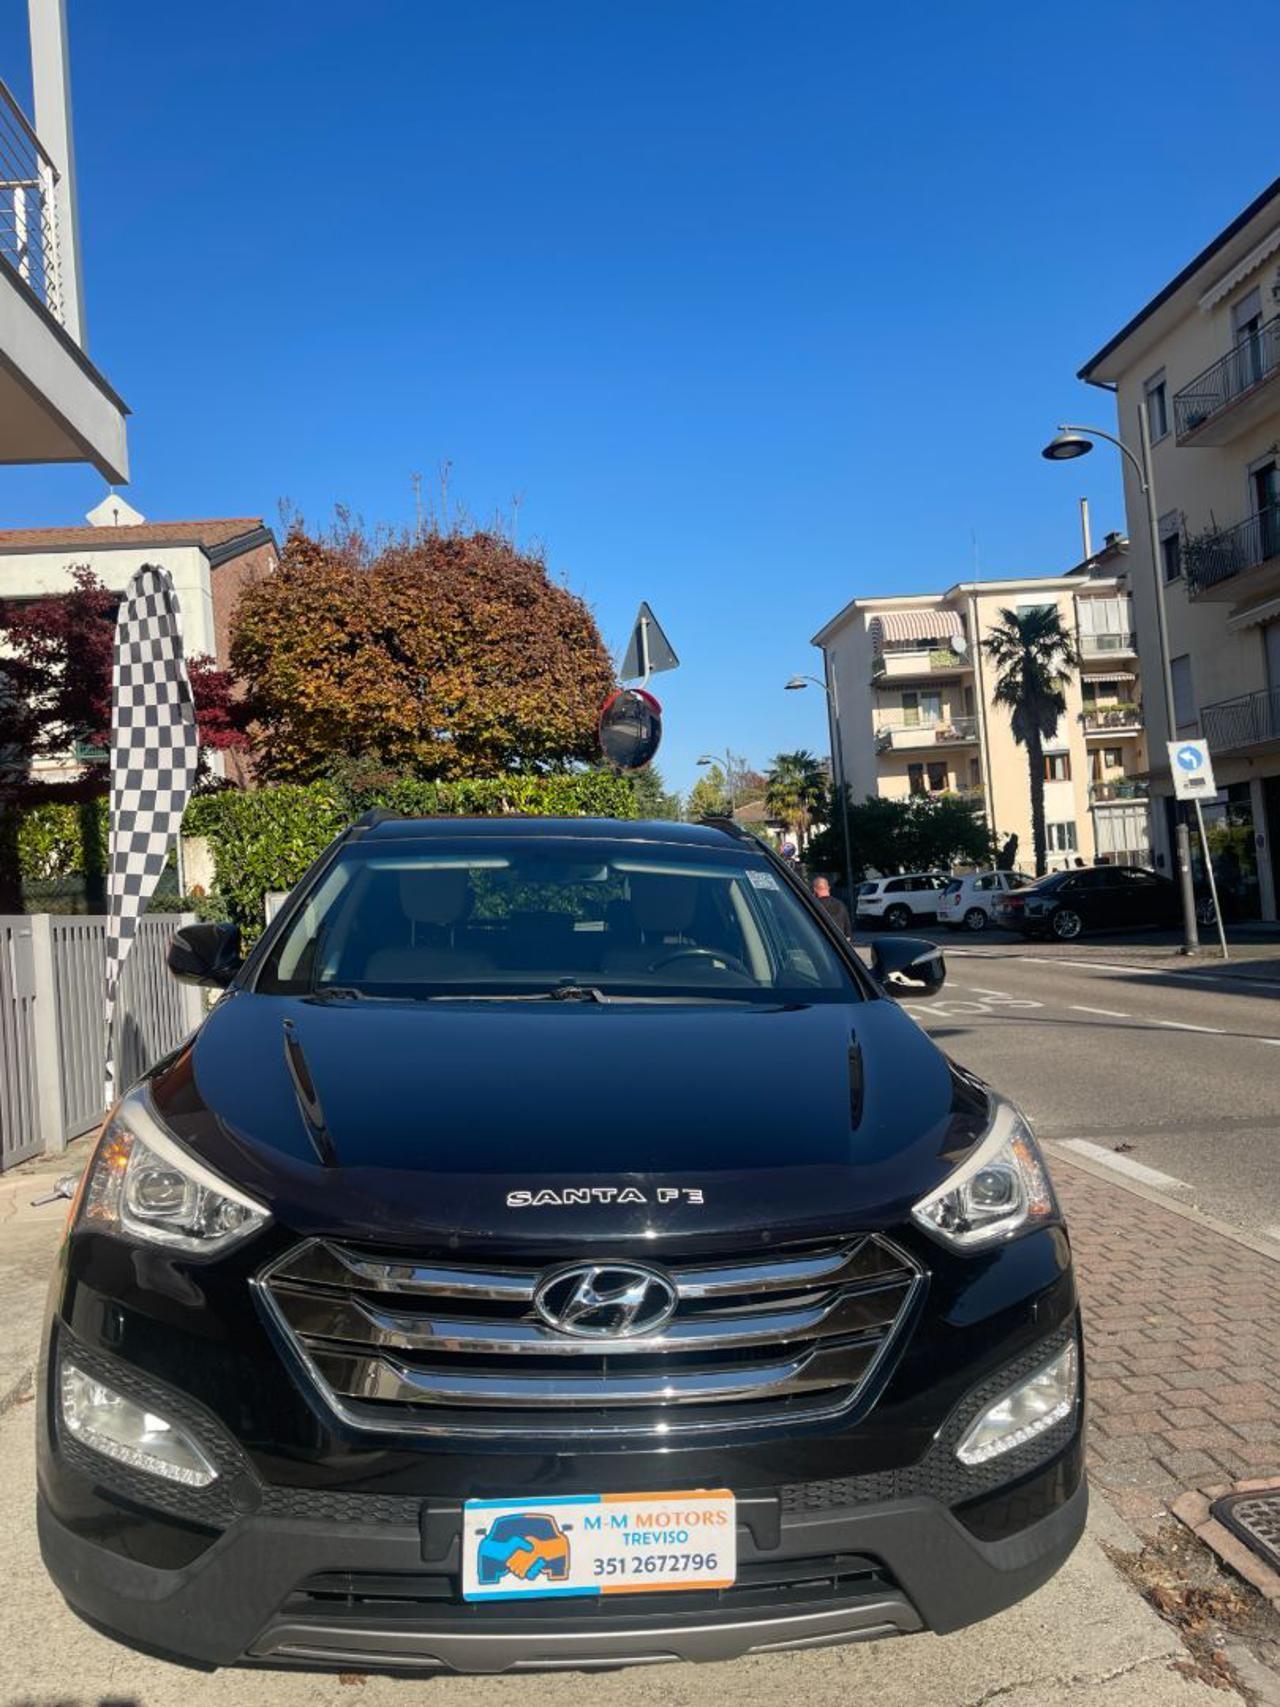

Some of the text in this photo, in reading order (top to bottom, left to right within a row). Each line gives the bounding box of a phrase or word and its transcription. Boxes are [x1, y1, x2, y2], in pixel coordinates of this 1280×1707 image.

[506, 1188, 646, 1206] SANTA
[583, 1510, 728, 1530] M-M MOTORS
[622, 1530, 689, 1546] TREVISO
[593, 1553, 718, 1576] 351 2672796
